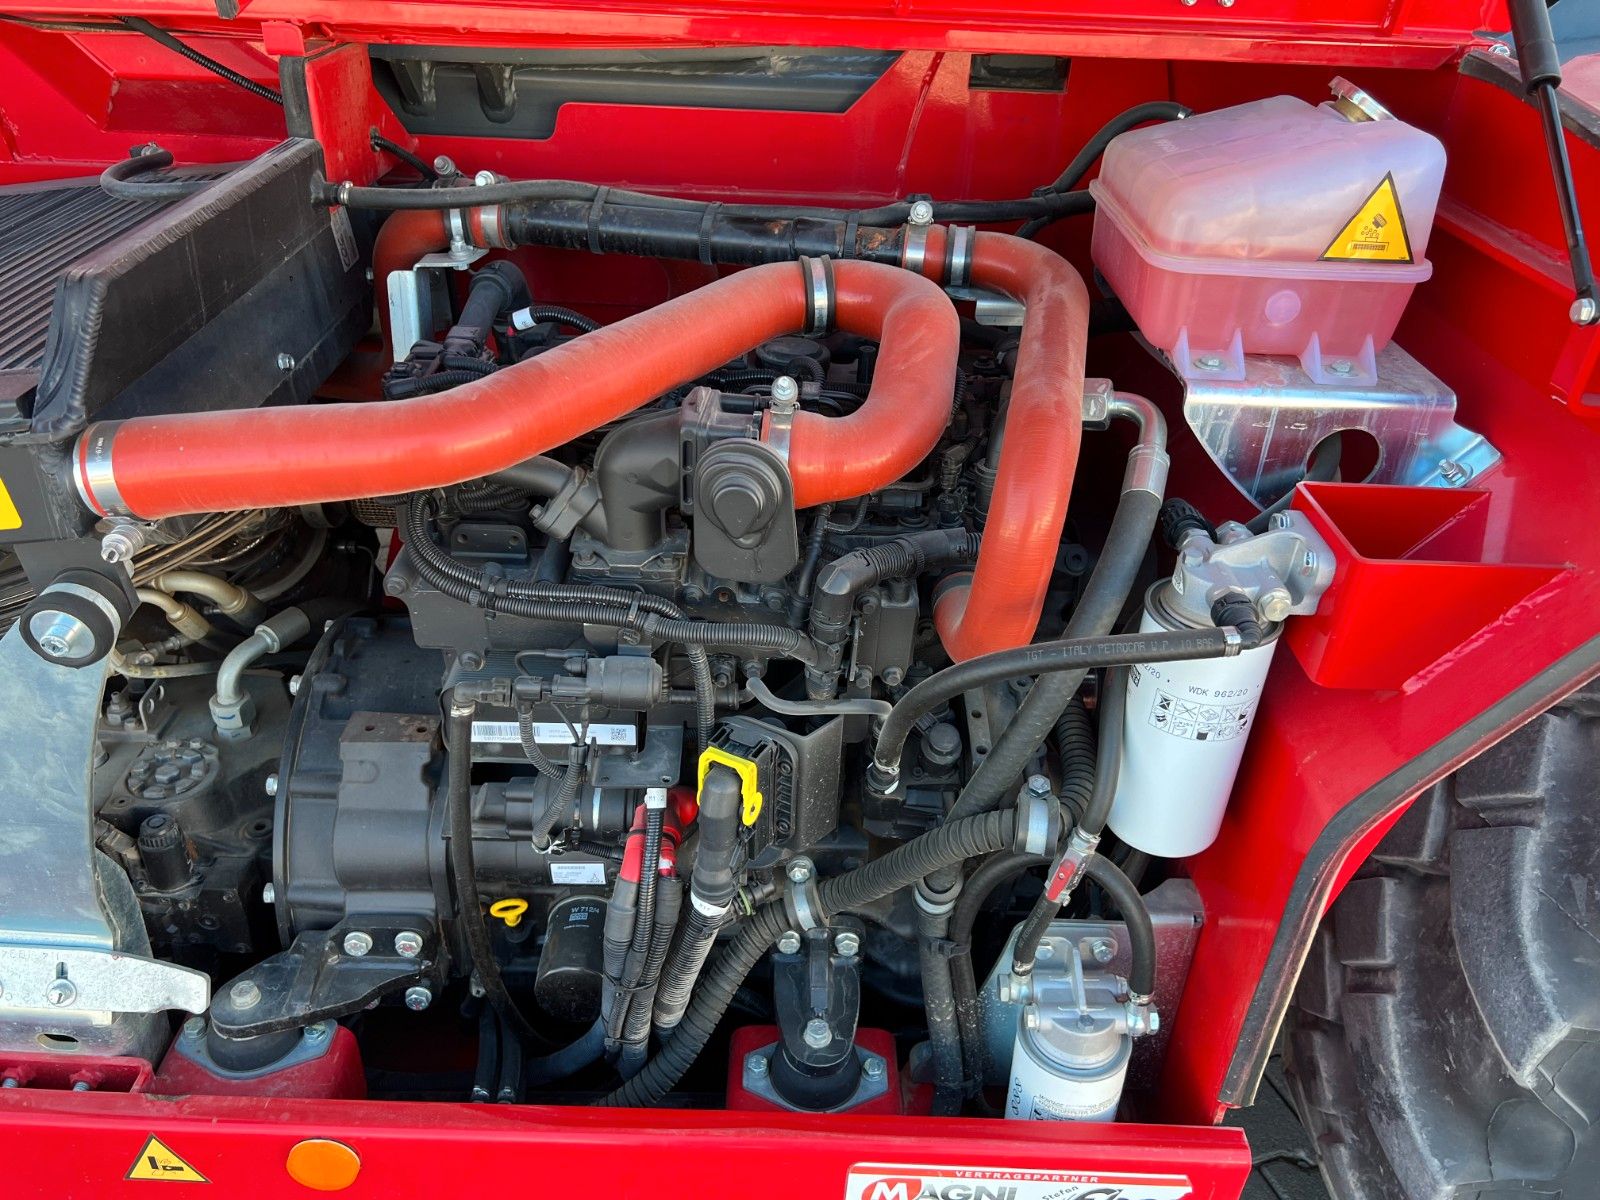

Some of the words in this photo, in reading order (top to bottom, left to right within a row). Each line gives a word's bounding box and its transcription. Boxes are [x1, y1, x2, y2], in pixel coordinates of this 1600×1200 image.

[1025, 651, 1044, 661] TGT
[1063, 645, 1092, 657] ITALY
[1180, 639, 1192, 650] 10
[1196, 637, 1214, 650] BAR
[1188, 685, 1209, 696] WDK
[1214, 688, 1249, 698] 962/20
[955, 1170, 1099, 1183] VERTRAGSPARTNER
[870, 1181, 1018, 1200] MAGNI
[1042, 1185, 1079, 1200] Stefan
